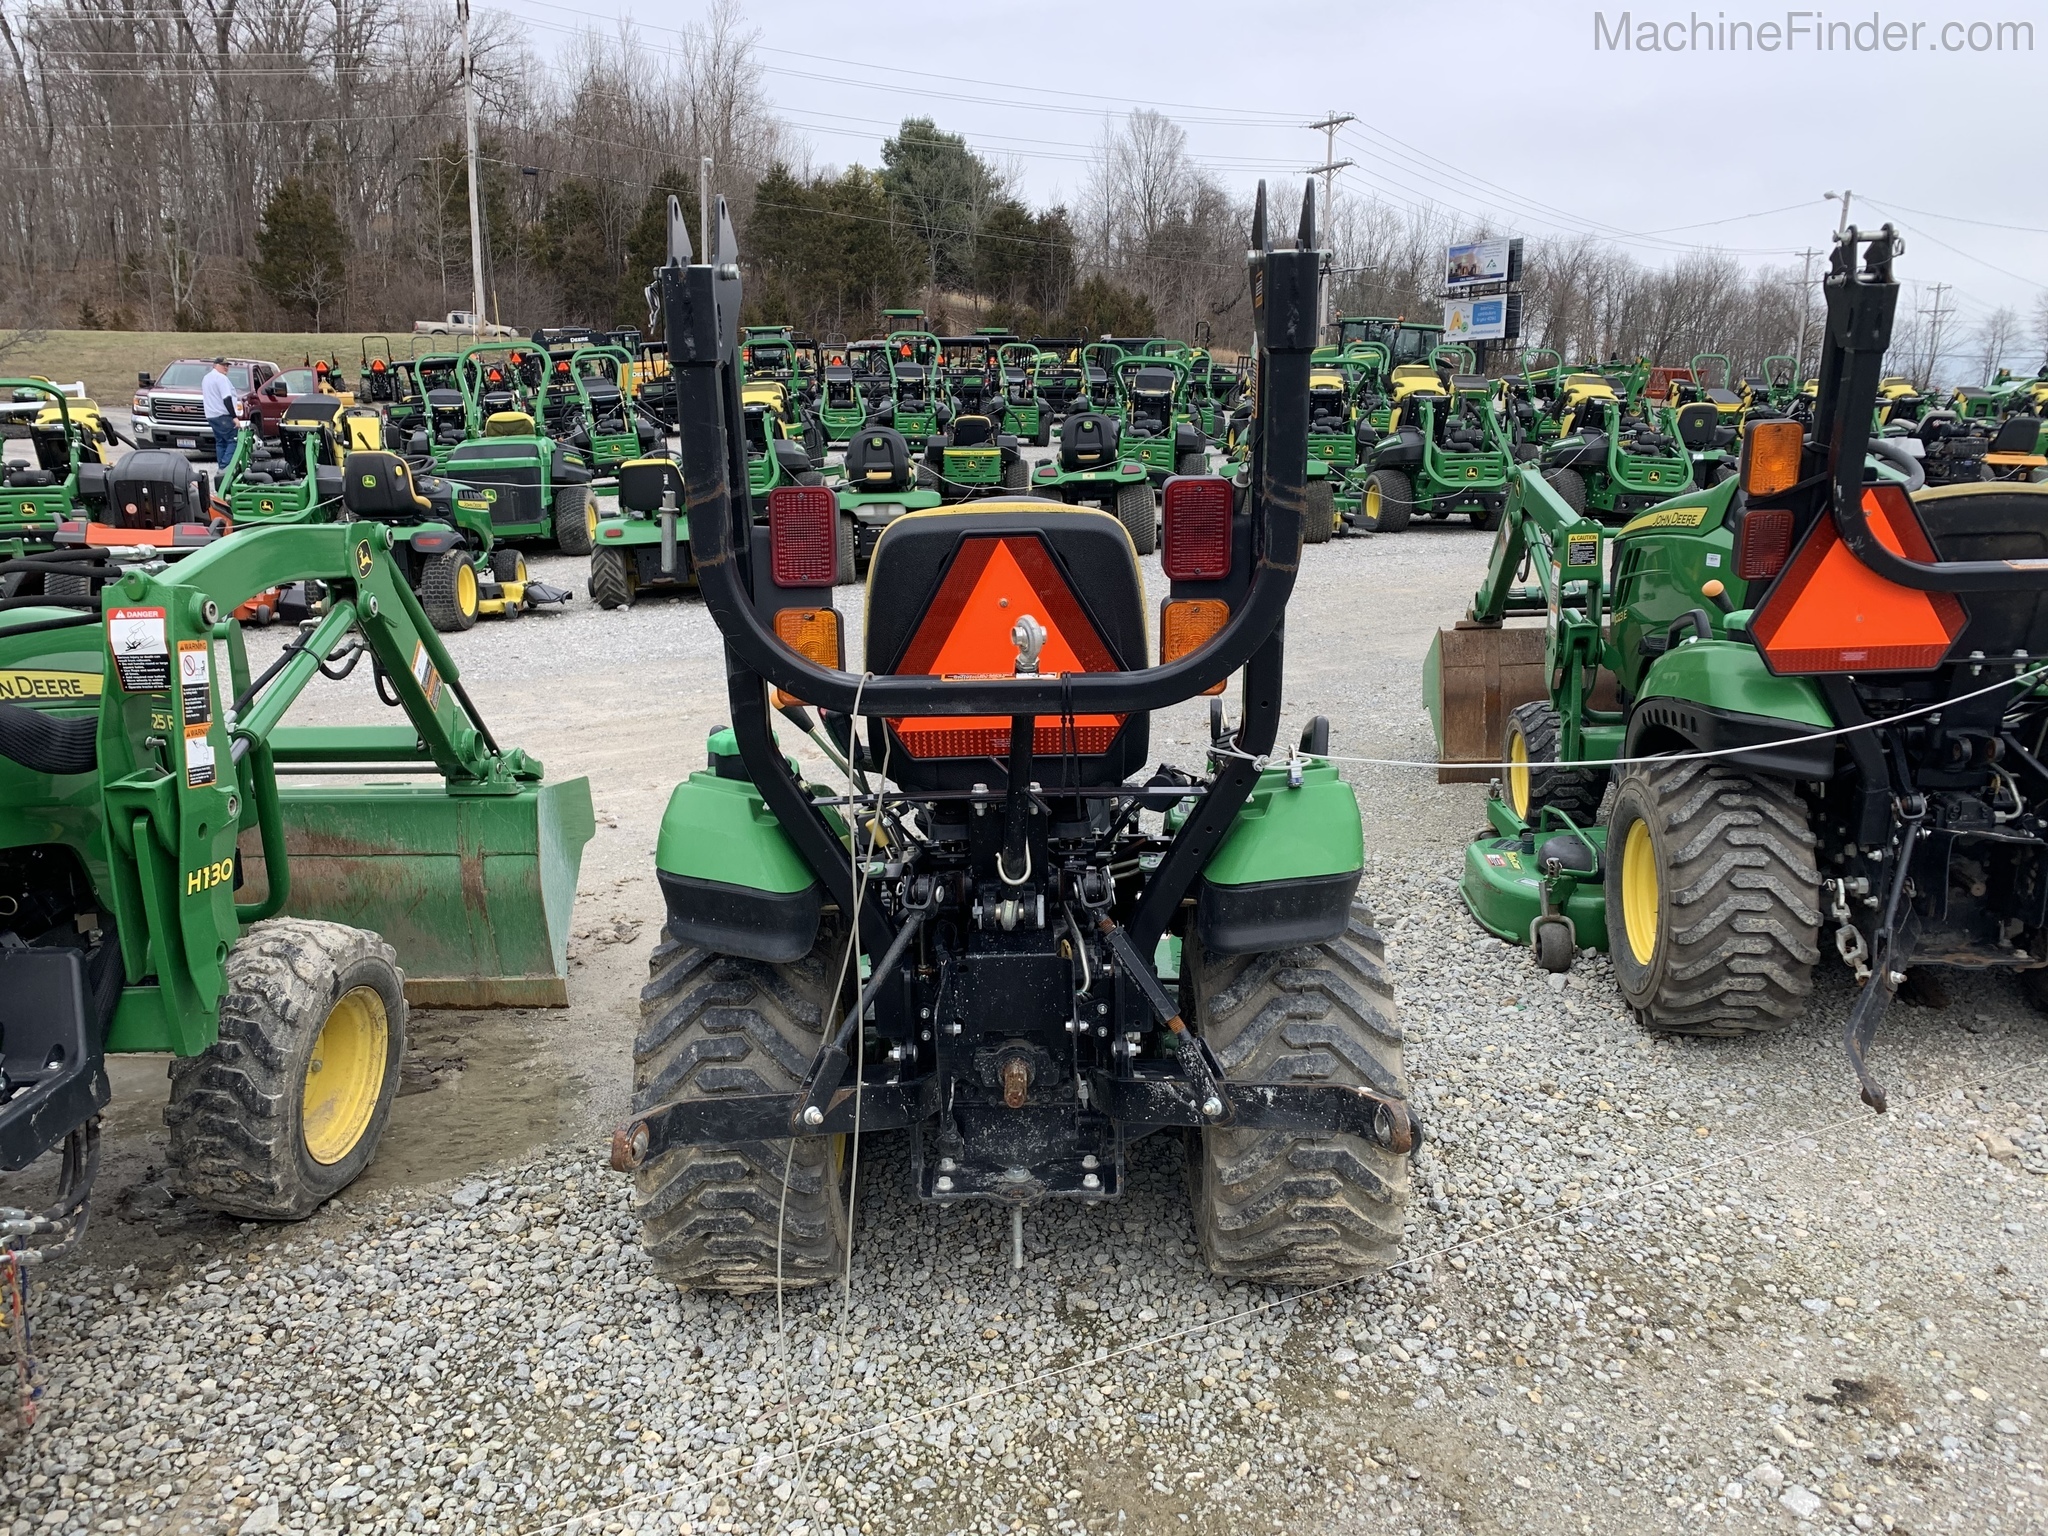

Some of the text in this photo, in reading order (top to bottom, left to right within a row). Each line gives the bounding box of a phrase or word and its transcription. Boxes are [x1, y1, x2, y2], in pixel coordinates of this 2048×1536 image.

[171, 404, 198, 413] GMC
[1672, 511, 1698, 525] DEERE
[126, 610, 159, 619] DANGER
[14, 676, 83, 696] DEERE
[151, 713, 166, 730] 25
[187, 857, 233, 896] H130
